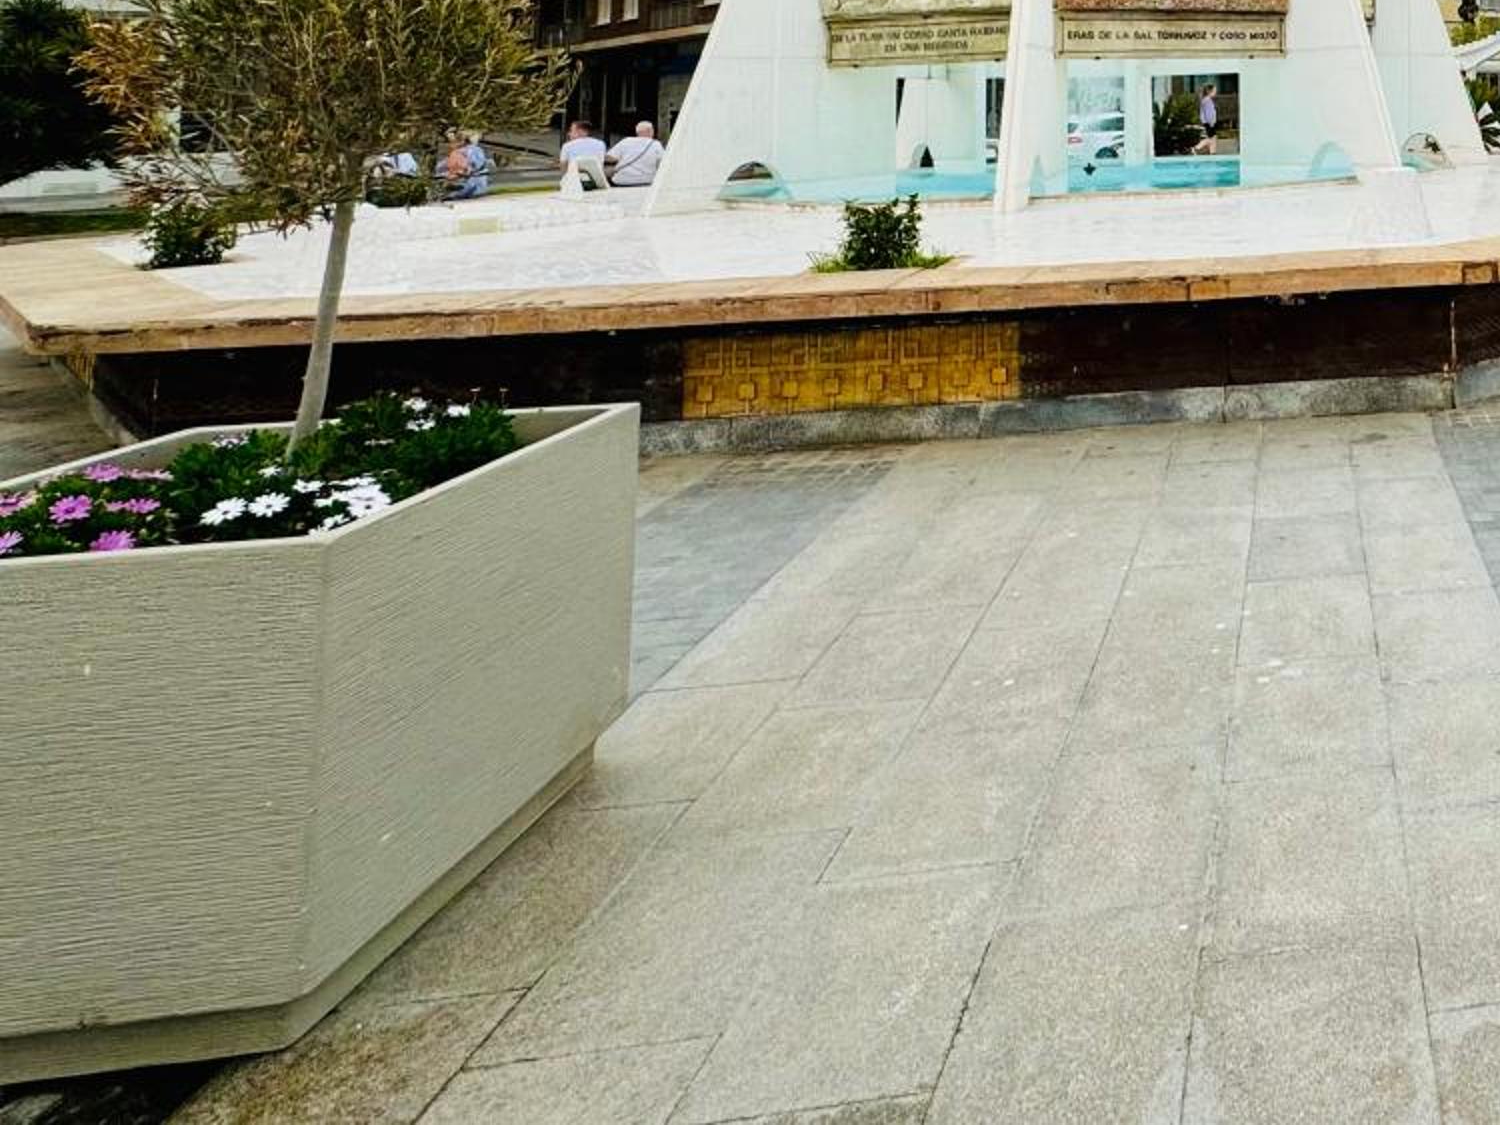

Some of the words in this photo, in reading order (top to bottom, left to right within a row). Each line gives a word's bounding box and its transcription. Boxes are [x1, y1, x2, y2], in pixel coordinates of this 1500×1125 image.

[1067, 30, 1094, 40] ERAS
[1098, 30, 1112, 40] DE
[1115, 30, 1130, 40] LA
[1133, 30, 1152, 40] SAL
